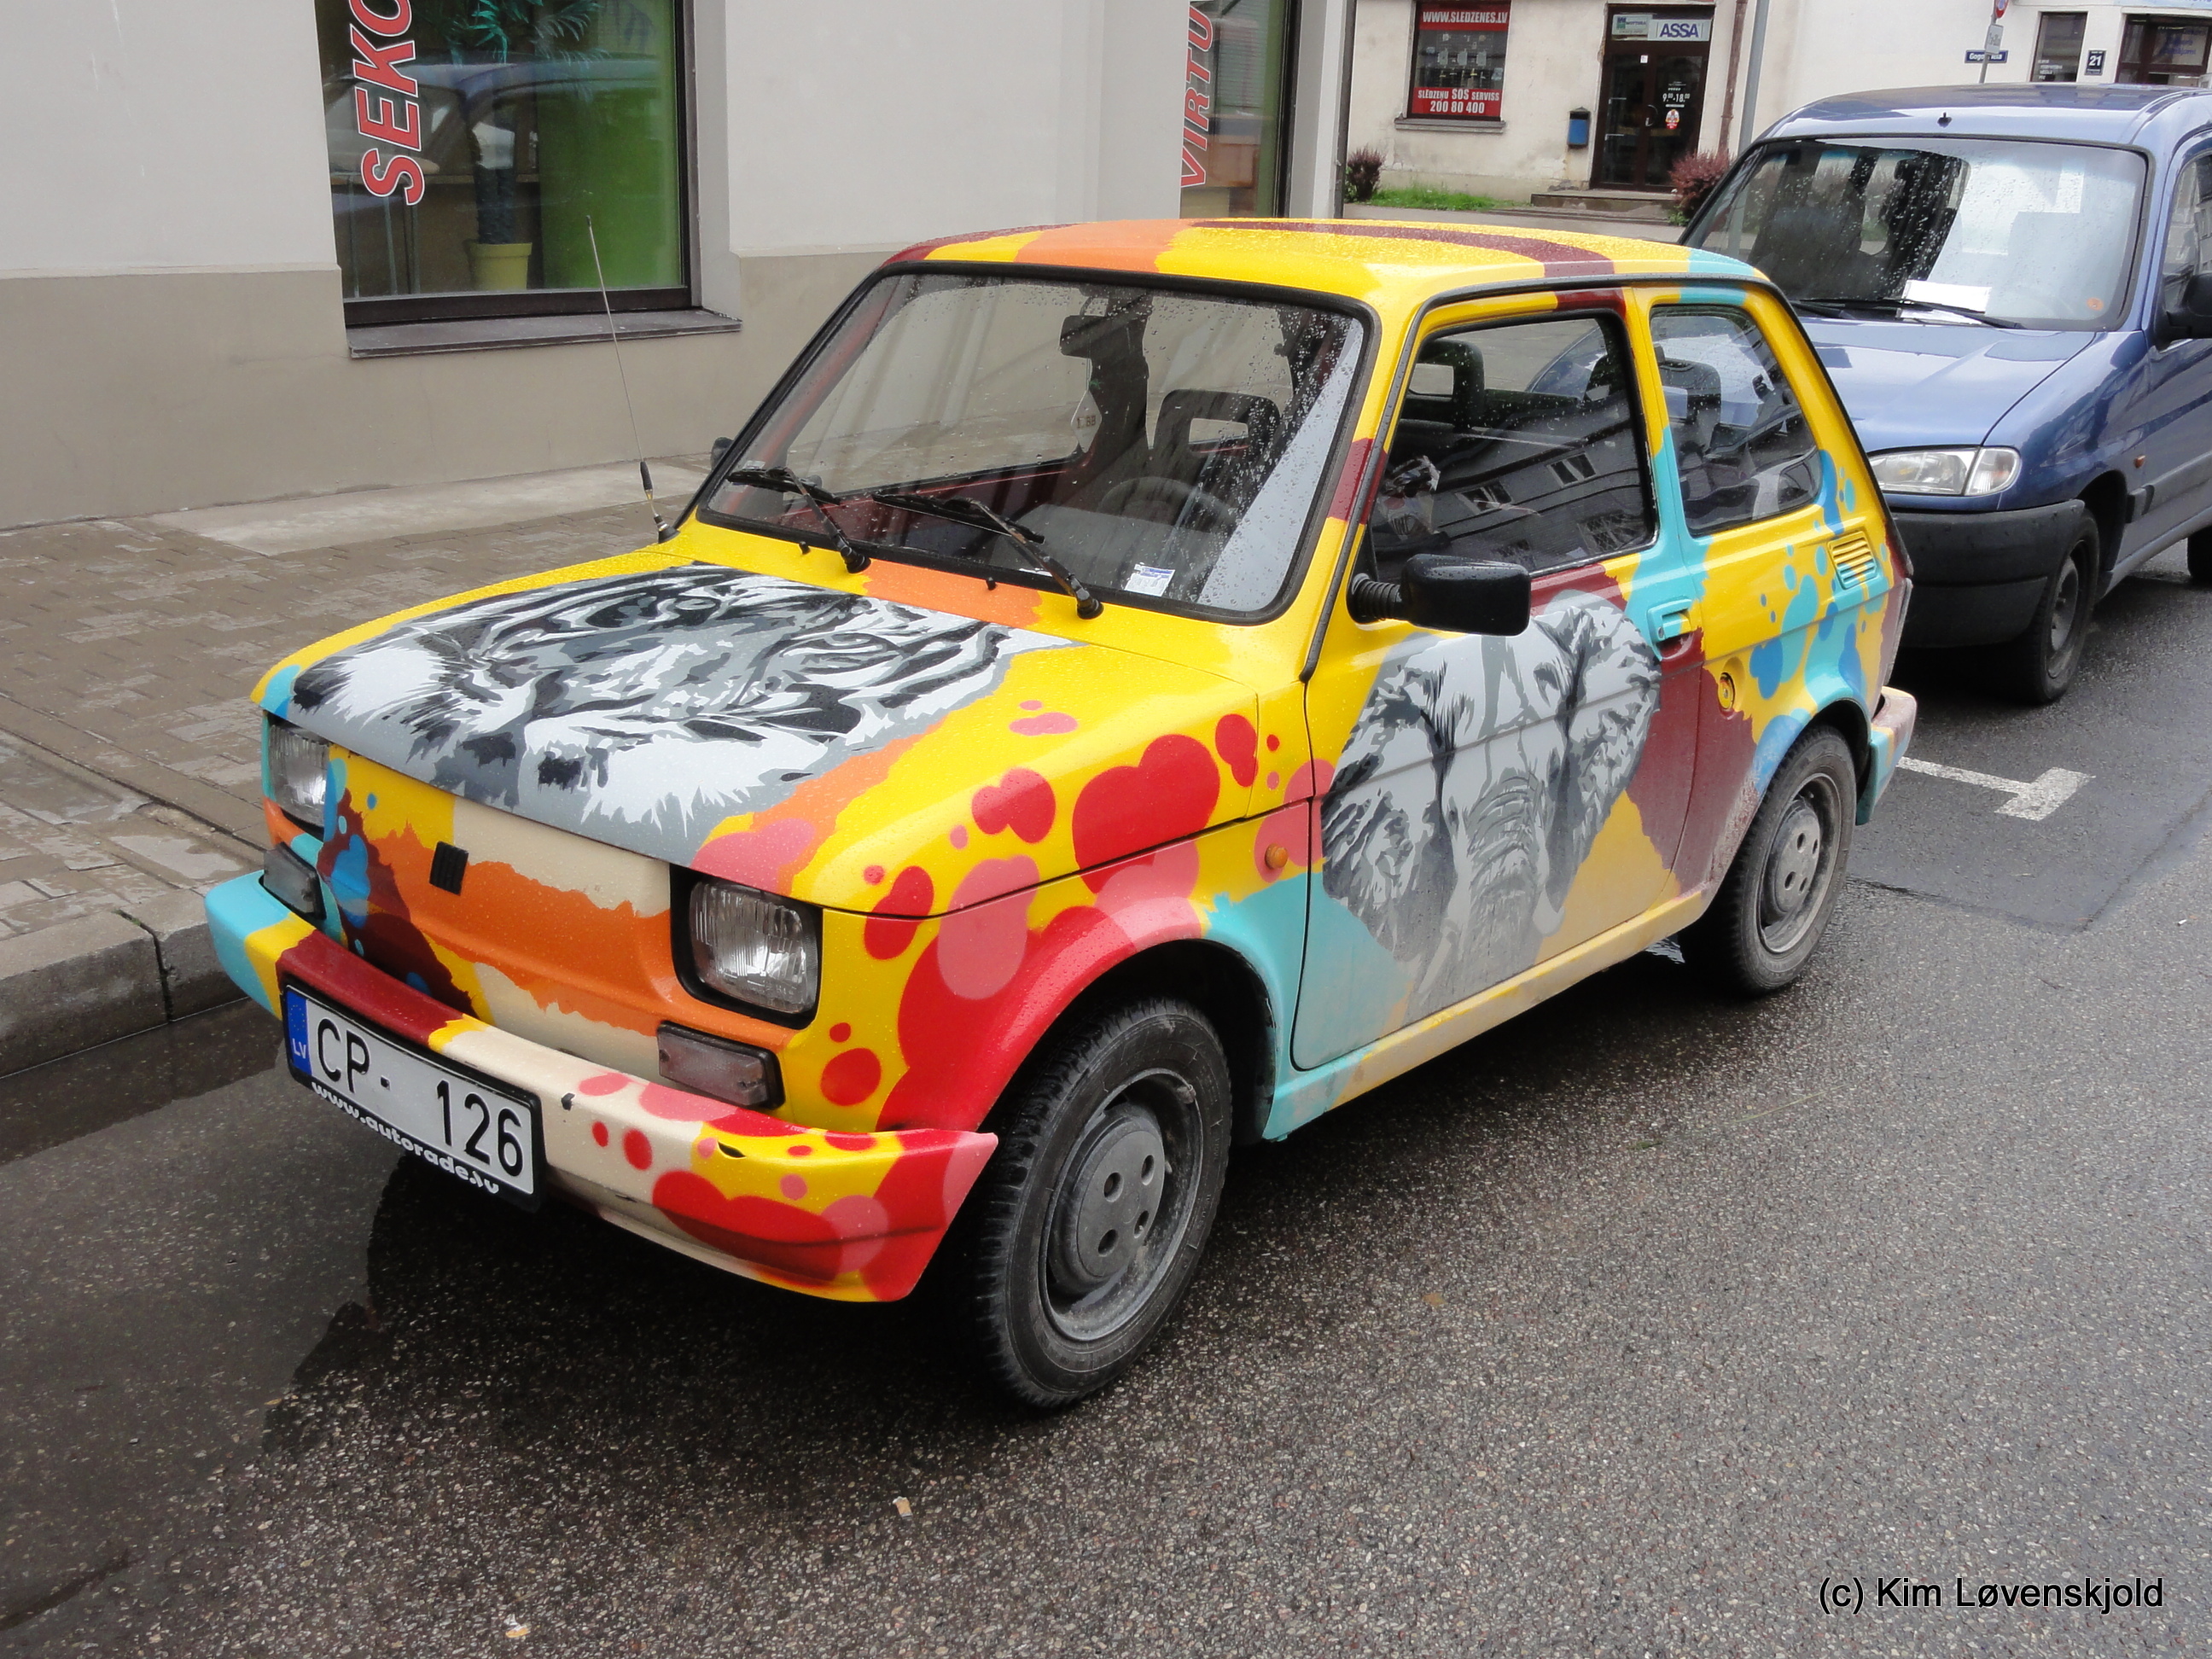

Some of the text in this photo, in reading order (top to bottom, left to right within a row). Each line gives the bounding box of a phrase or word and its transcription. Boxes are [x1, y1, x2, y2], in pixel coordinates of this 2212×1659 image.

[1423, 11, 1508, 24] WWW.SLEDZENES.LV
[1659, 22, 1699, 38] ASSA
[1969, 52, 1990, 61] Gogo
[2088, 55, 2103, 67] 21
[1180, 4, 1214, 188] VIRTU
[1452, 88, 1470, 101] SOS
[1471, 91, 1500, 101] SERVISS
[350, 0, 425, 206] SEKO
[1429, 100, 1485, 114] 200 80 400
[291, 1038, 307, 1060] LV
[311, 1081, 500, 1195] www.autorade.lv
